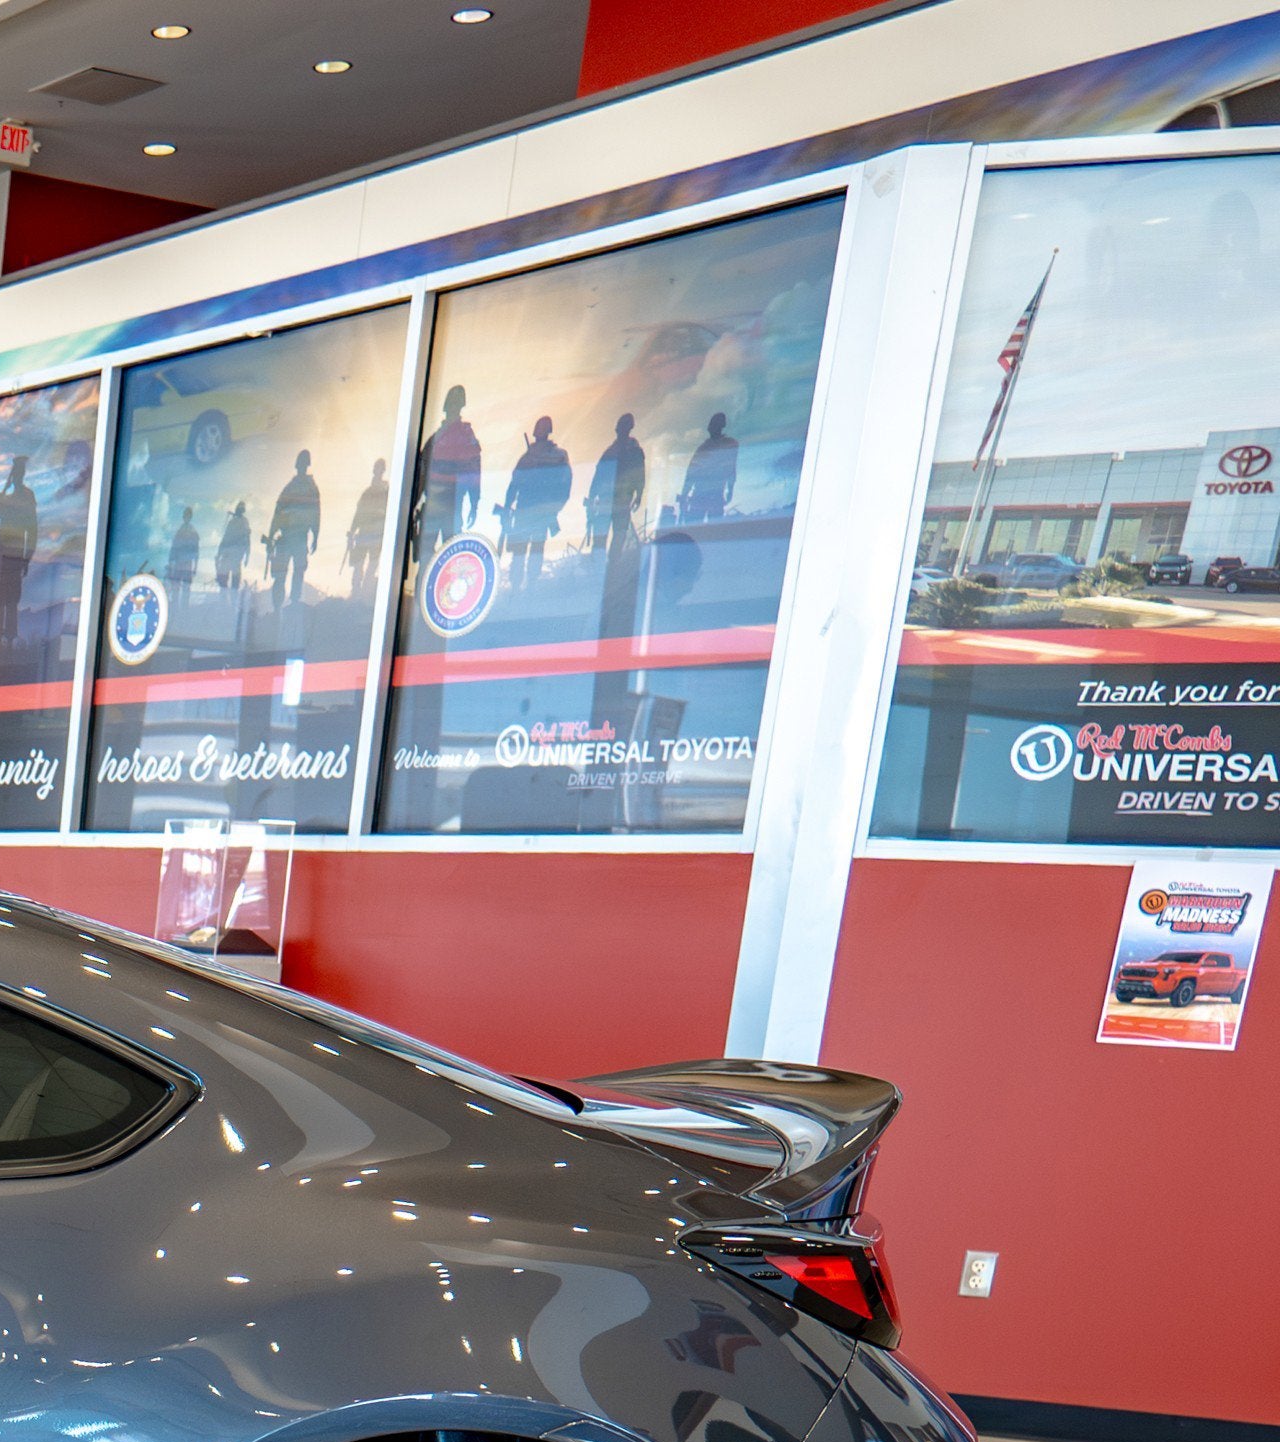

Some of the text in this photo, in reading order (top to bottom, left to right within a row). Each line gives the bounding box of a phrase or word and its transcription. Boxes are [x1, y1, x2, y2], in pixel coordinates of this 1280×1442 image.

[0, 124, 29, 153] EXIT
[1204, 481, 1274, 495] TOYOTA
[1077, 679, 1280, 706] Thank you for
[531, 721, 556, 746] Red
[1076, 722, 1231, 759] Red McCombs
[97, 734, 351, 783] heroes & veterans
[393, 744, 481, 770] Welcome to
[528, 736, 754, 766] UNIVERSAL TOYOTA
[567, 770, 682, 787] DRIVEN TO SERVE
[1117, 791, 1216, 811] DRIVEN
[1223, 791, 1259, 811] TO
[1162, 907, 1241, 924] MADNESS
